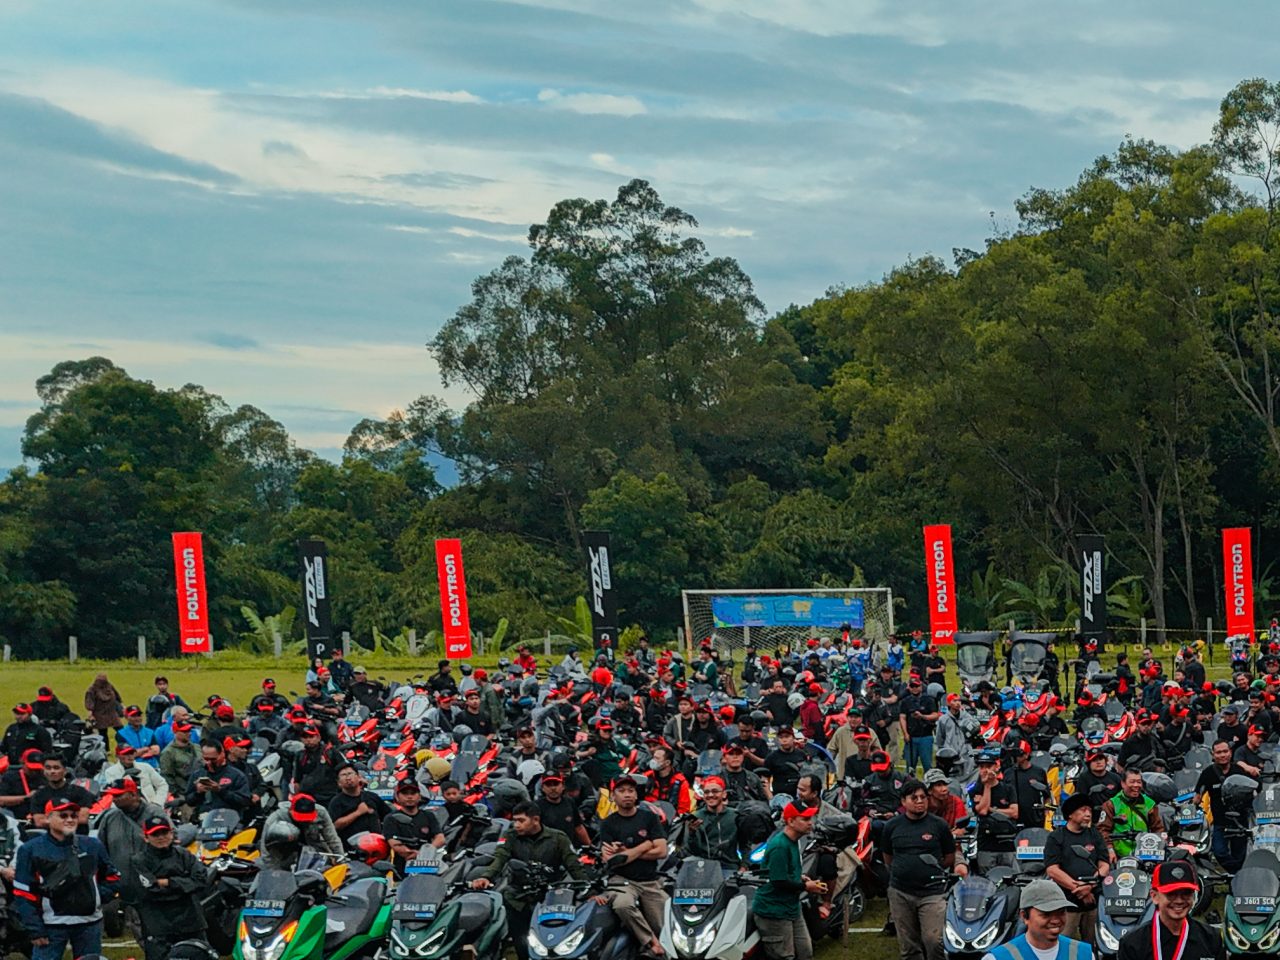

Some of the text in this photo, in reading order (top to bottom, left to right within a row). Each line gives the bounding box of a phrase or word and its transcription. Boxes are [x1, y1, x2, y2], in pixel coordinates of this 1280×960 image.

[183, 548, 199, 620] POLYTRON
[444, 554, 461, 627] POLYTRON
[933, 540, 948, 612] POLYTRON
[1232, 543, 1245, 616] POLYTRON
